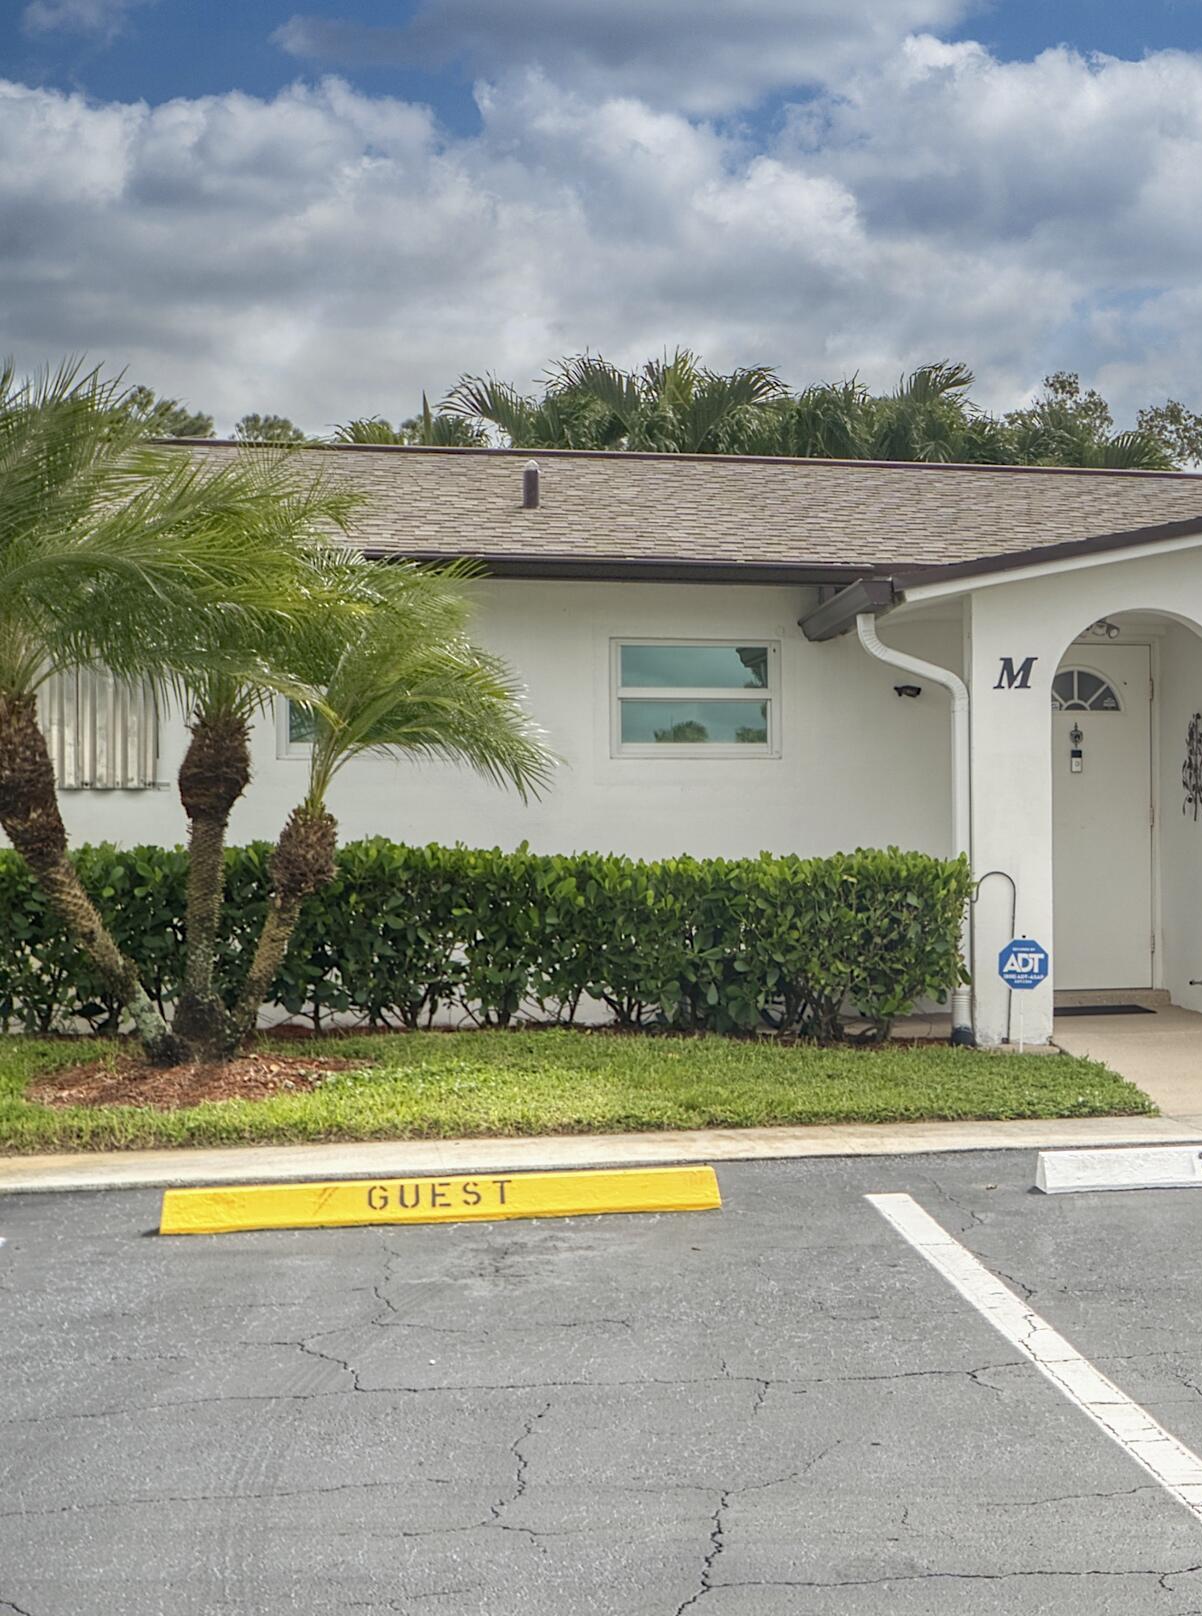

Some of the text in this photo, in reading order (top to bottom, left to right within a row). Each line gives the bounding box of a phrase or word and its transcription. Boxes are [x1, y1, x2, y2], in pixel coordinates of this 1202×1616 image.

[993, 657, 1038, 689] M
[1003, 953, 1045, 973] ADT
[368, 1180, 512, 1210] GUEST
